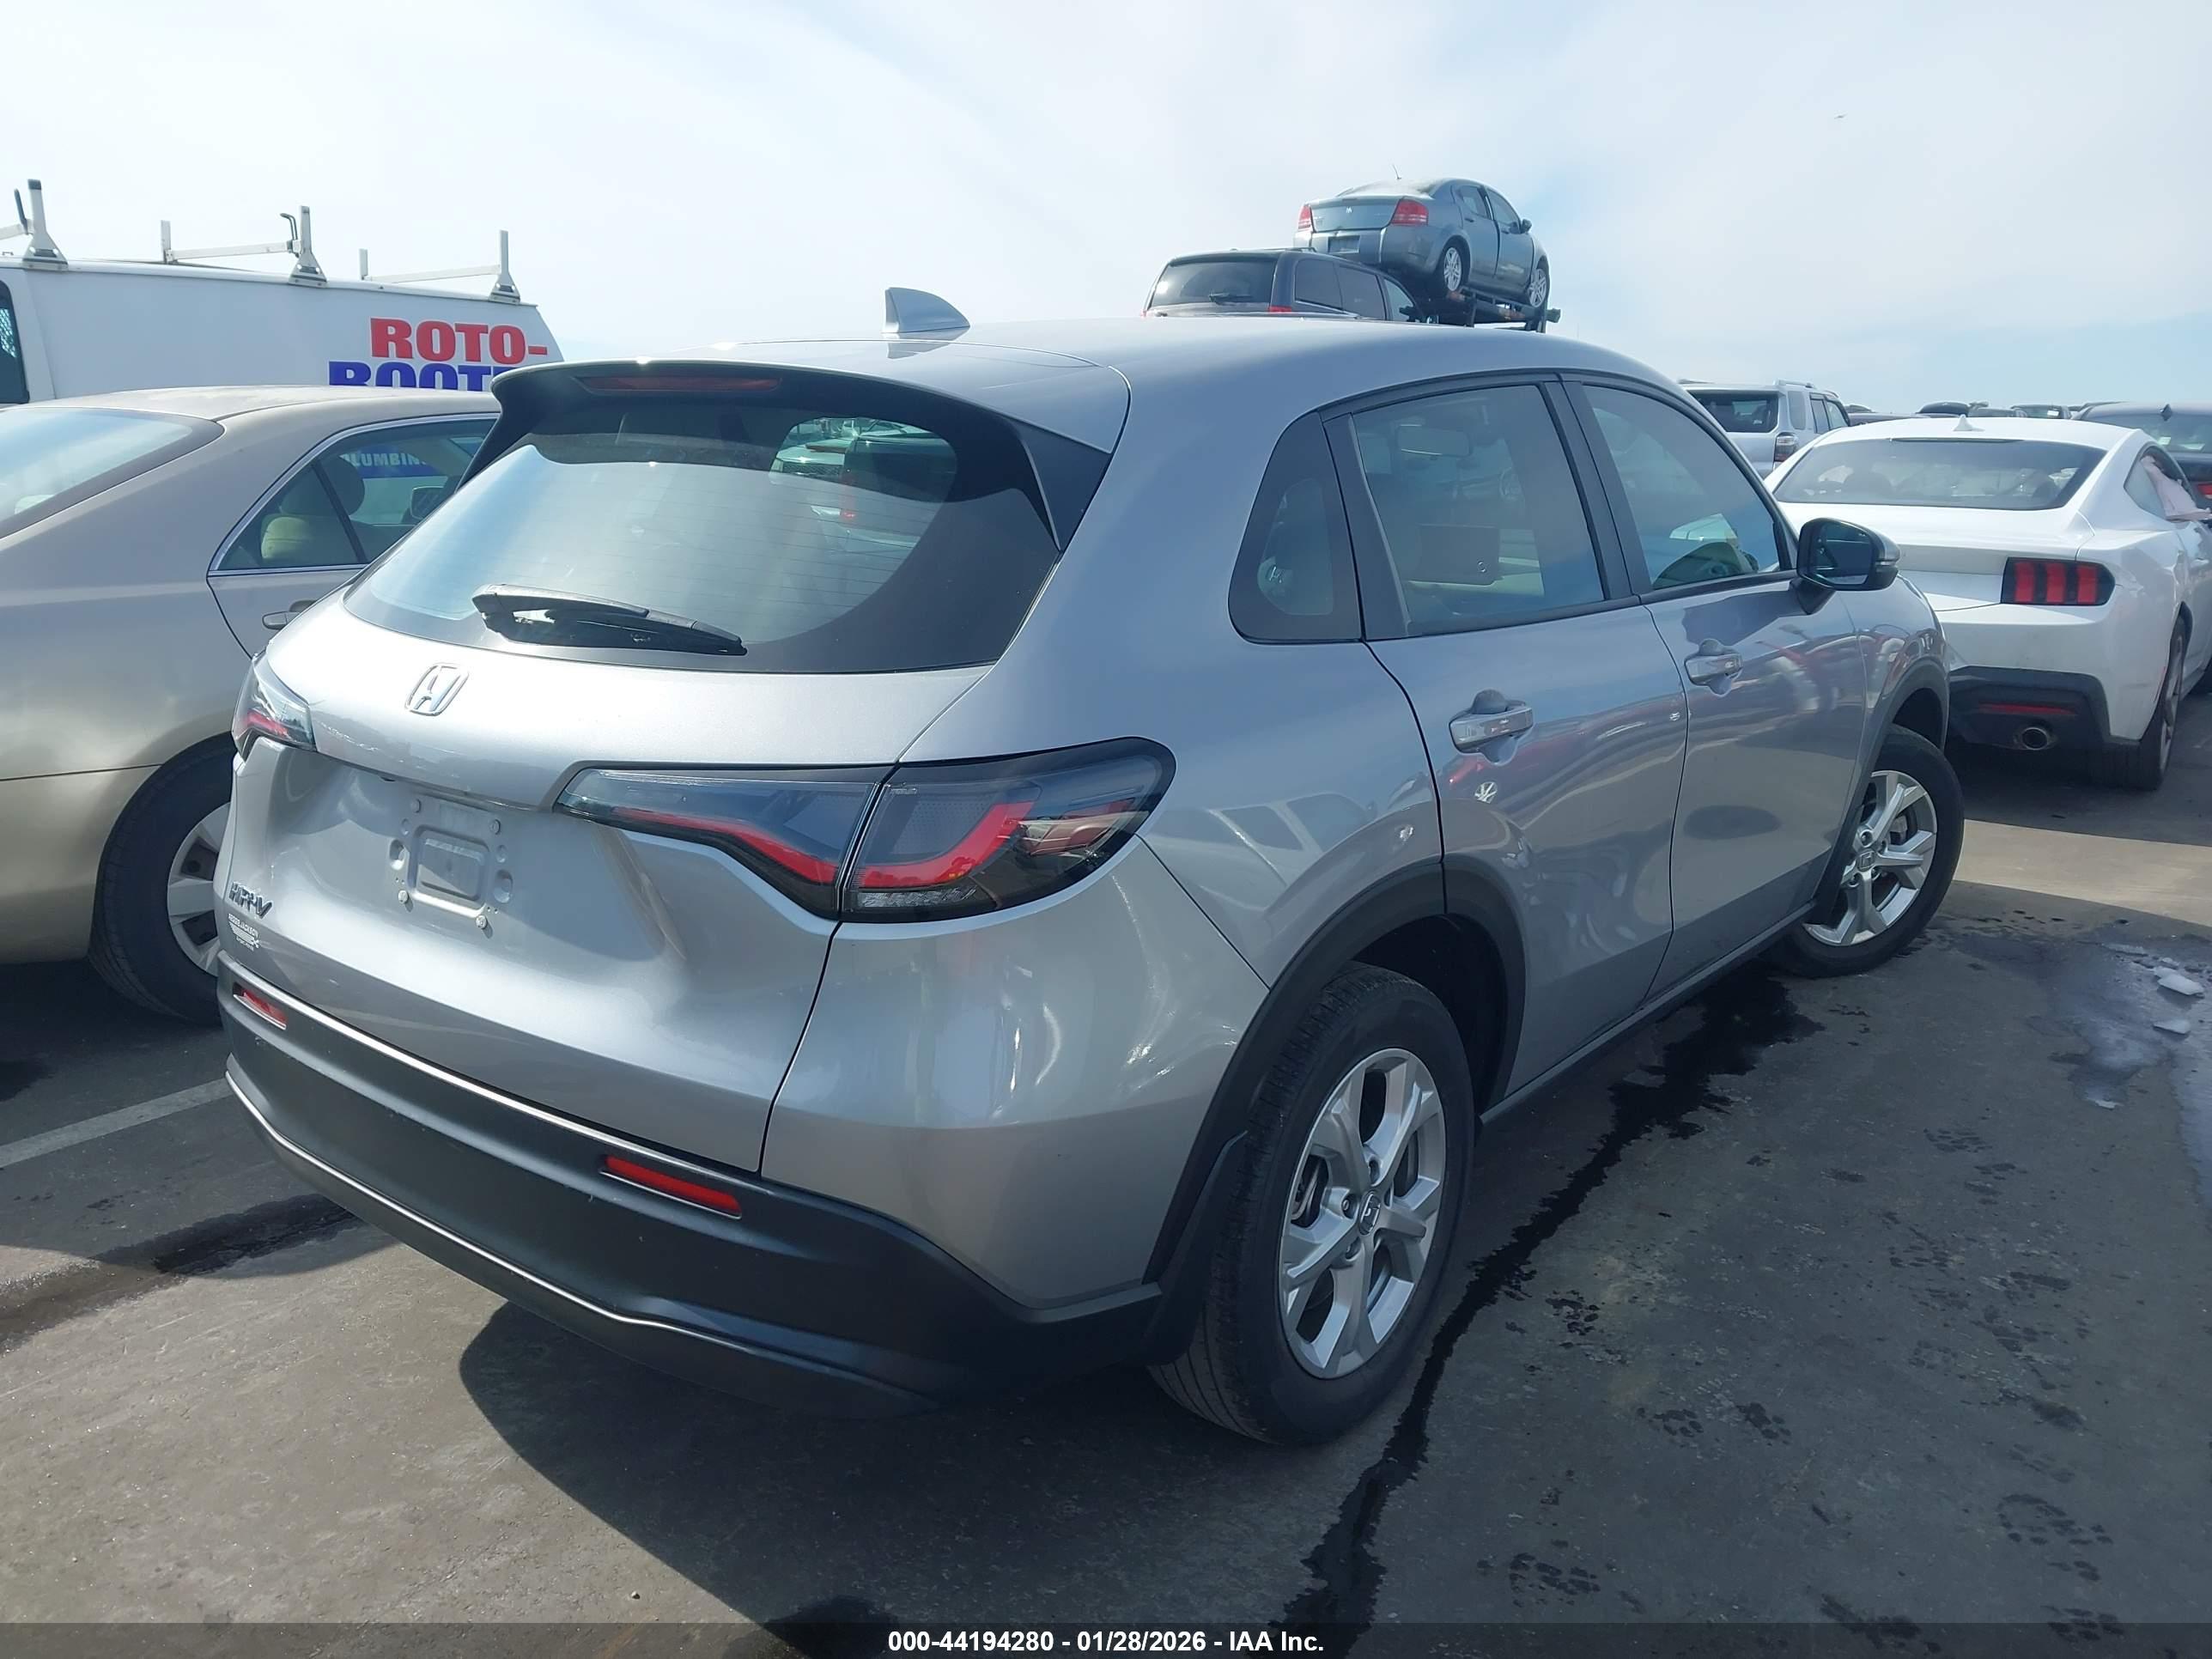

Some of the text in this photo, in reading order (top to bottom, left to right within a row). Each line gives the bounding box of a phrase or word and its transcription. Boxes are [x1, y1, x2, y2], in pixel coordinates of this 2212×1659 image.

[370, 317, 548, 365] ROTO-
[328, 361, 520, 392] ROOT
[340, 453, 427, 468] LUMBIN
